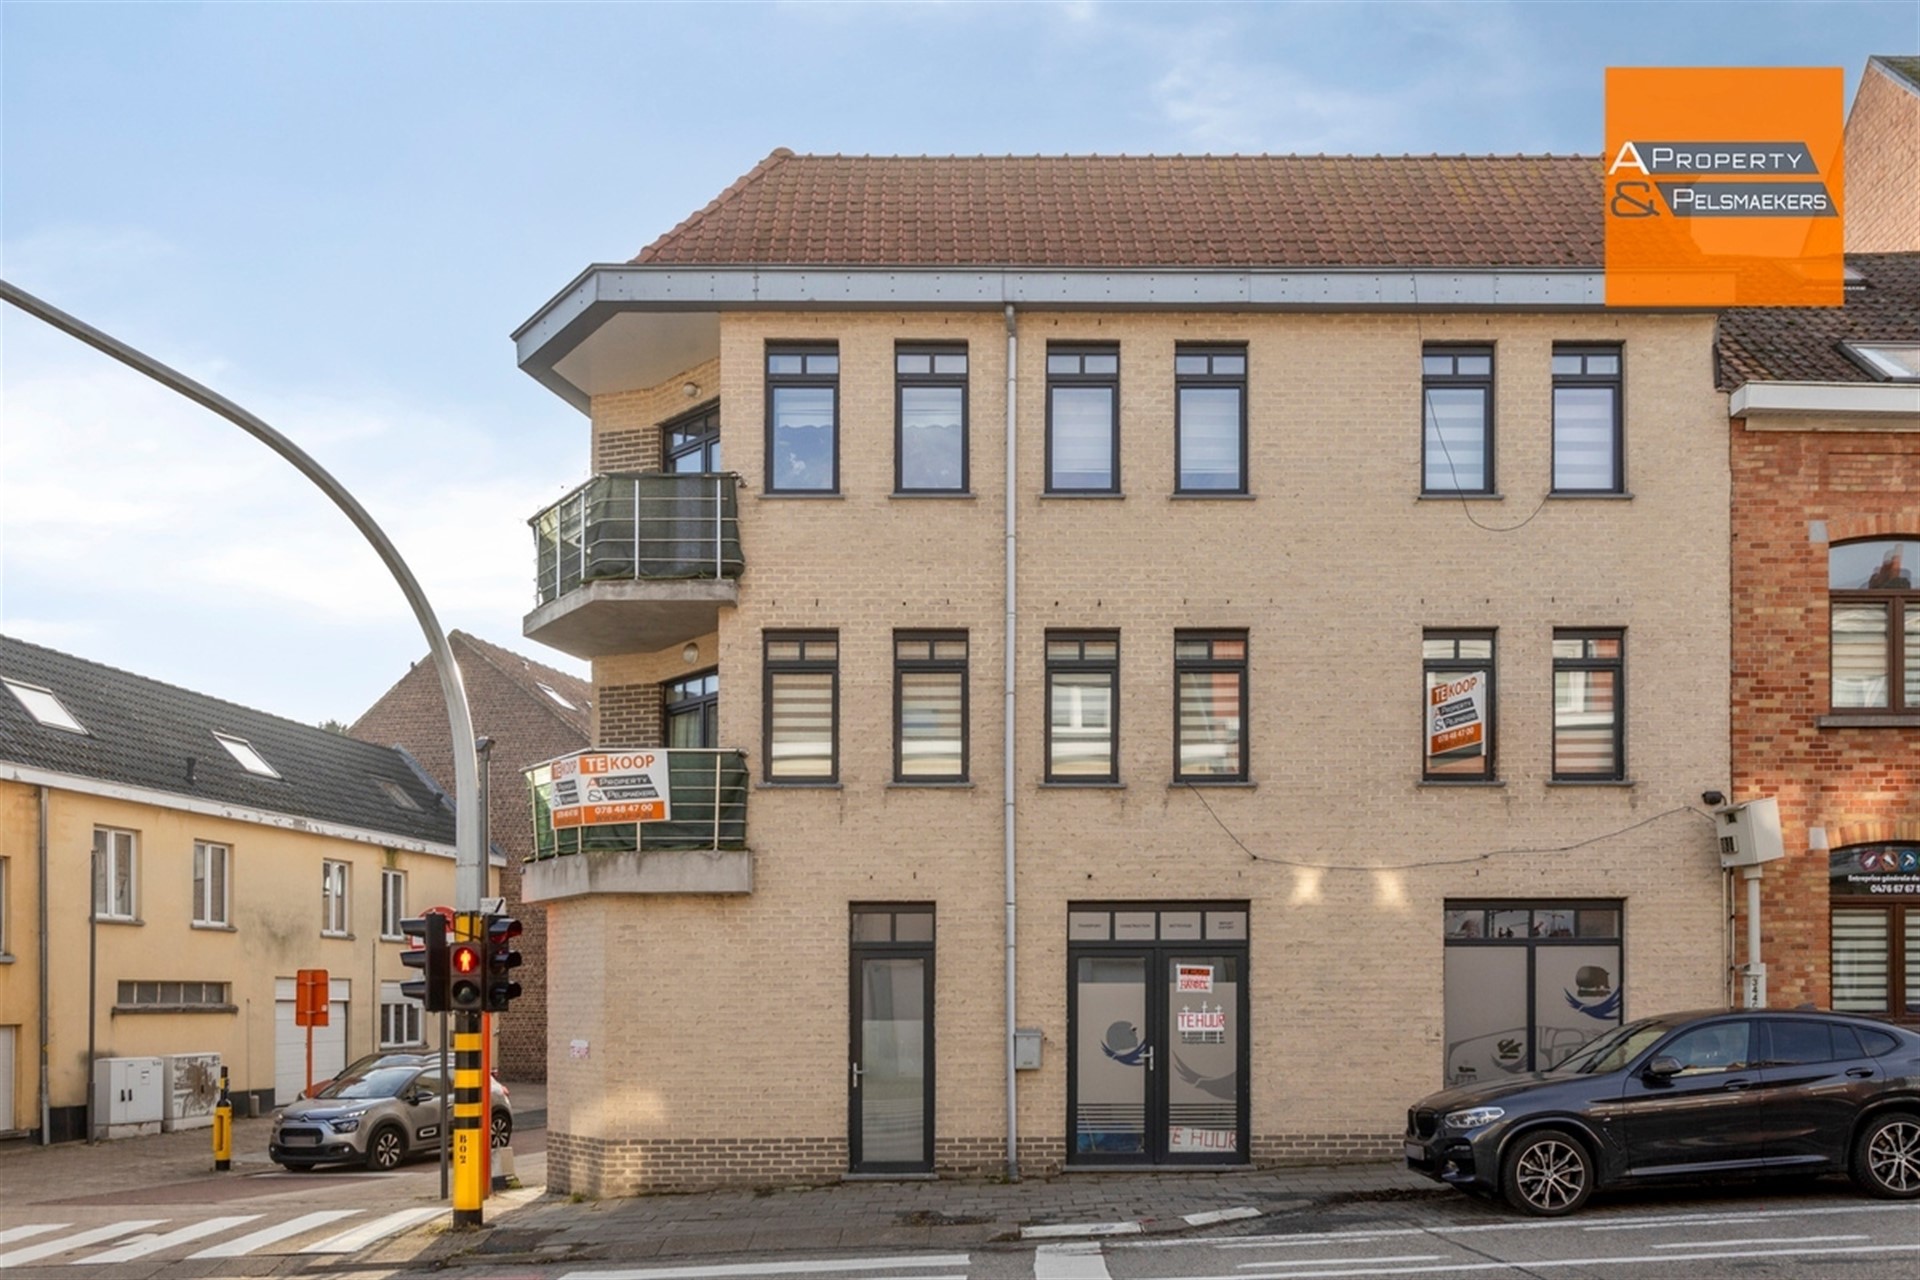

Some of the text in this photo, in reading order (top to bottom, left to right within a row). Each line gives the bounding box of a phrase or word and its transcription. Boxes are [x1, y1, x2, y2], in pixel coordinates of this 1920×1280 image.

[1435, 677, 1478, 702] TE KOOP
[586, 754, 655, 772] TE KOOP
[594, 802, 653, 815] 078 48 47 00
[1179, 1013, 1226, 1028] TE HUUR
[1190, 1130, 1237, 1148] HUUR
[459, 1134, 468, 1165] B02
